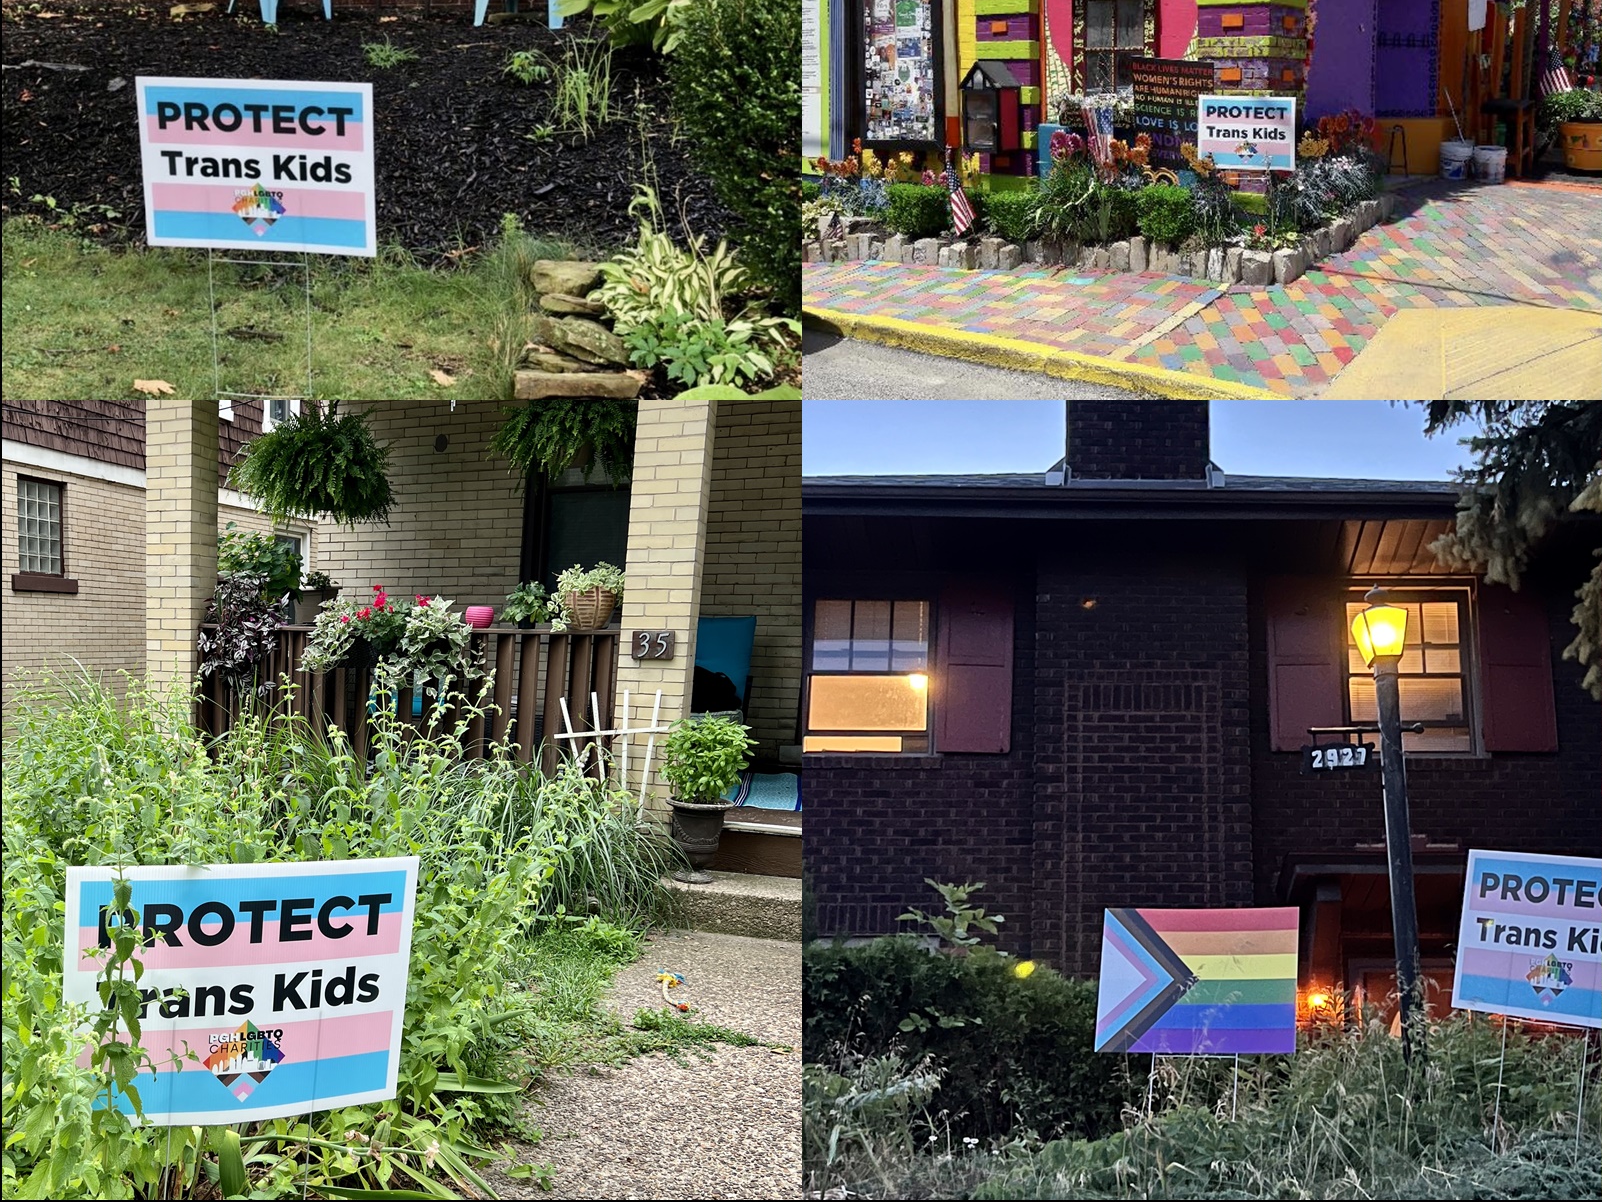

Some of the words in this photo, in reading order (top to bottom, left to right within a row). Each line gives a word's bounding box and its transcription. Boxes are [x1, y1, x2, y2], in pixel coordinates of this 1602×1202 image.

[1132, 61, 1155, 71] BLACK
[1157, 64, 1178, 74] LIVES
[1181, 67, 1213, 76] MATTER
[1133, 73, 1177, 85] WOMEN'S
[1180, 77, 1213, 87] RIGHTS
[1135, 84, 1149, 93] ARE
[1151, 85, 1181, 96] HUMAN
[1134, 103, 1172, 115] SCIENCE
[1176, 108, 1185, 117] IS
[1206, 105, 1287, 120] PROTECT
[157, 101, 353, 136] PROTECT
[1136, 116, 1164, 128] LOVE
[1169, 119, 1179, 130] IS
[1184, 121, 1198, 132] LO
[1206, 125, 1248, 139] Trans
[1253, 127, 1286, 140] Kids
[161, 150, 261, 179] Trans
[273, 154, 352, 183] Kids
[637, 632, 670, 658] 35
[1311, 747, 1366, 769] 2927
[1479, 872, 1602, 909] PROTE
[1477, 917, 1557, 950] Trans
[1567, 926, 1602, 955] Ki
[272, 965, 380, 1012] Kids
[209, 1039, 281, 1054] CHARITIES
